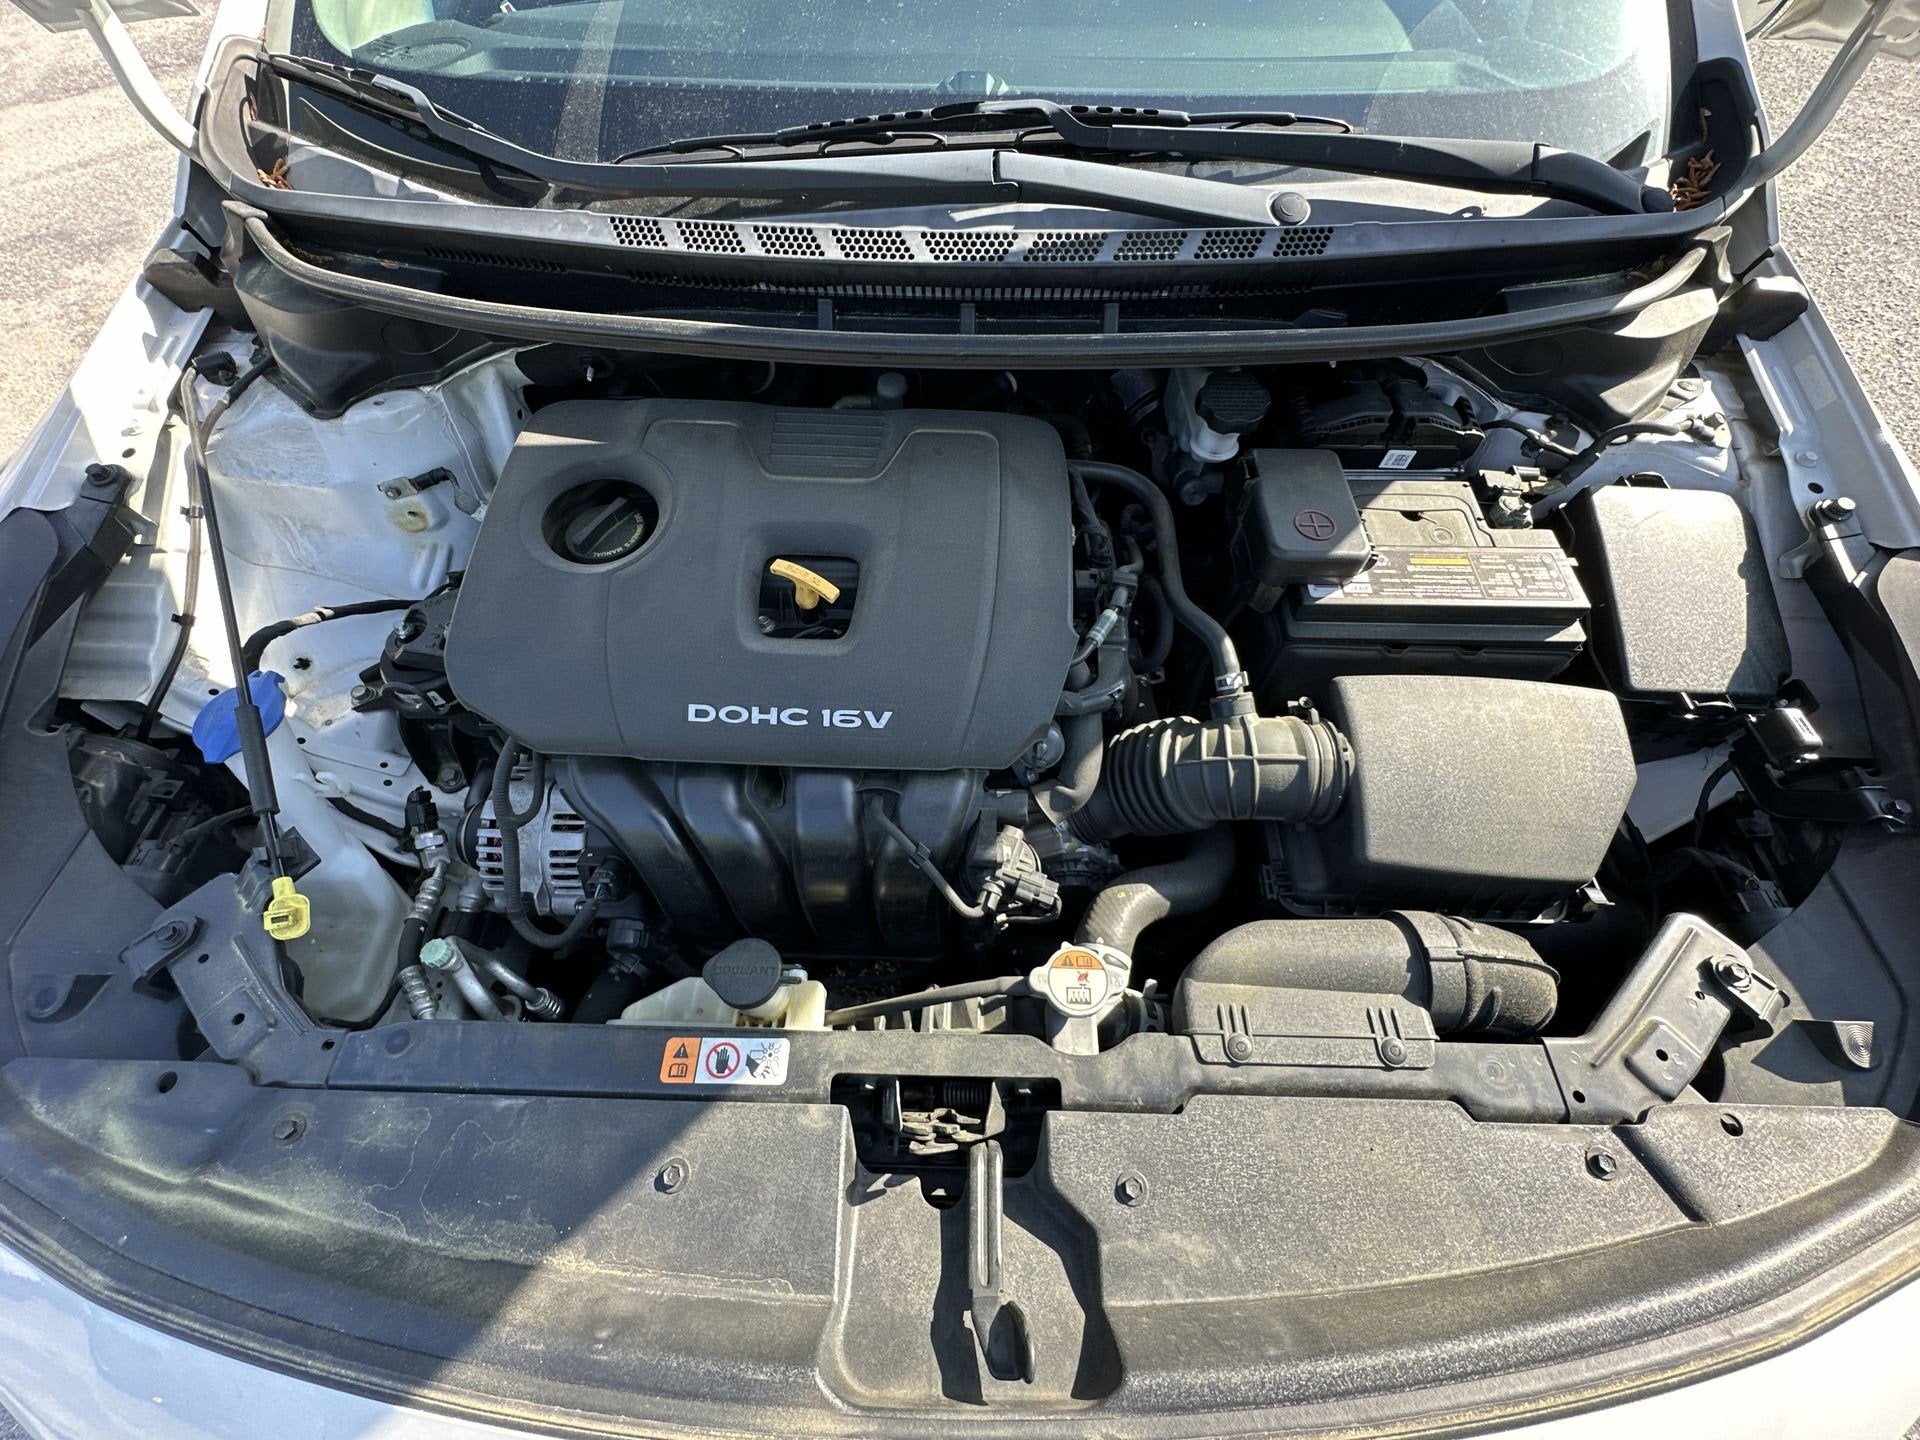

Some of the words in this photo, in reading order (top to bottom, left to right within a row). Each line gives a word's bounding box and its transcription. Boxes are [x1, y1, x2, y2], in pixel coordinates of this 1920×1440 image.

[592, 547, 623, 558] MANUAL
[687, 703, 809, 726] DOHC
[821, 708, 893, 729] 16V
[715, 964, 779, 977] COOLANT
